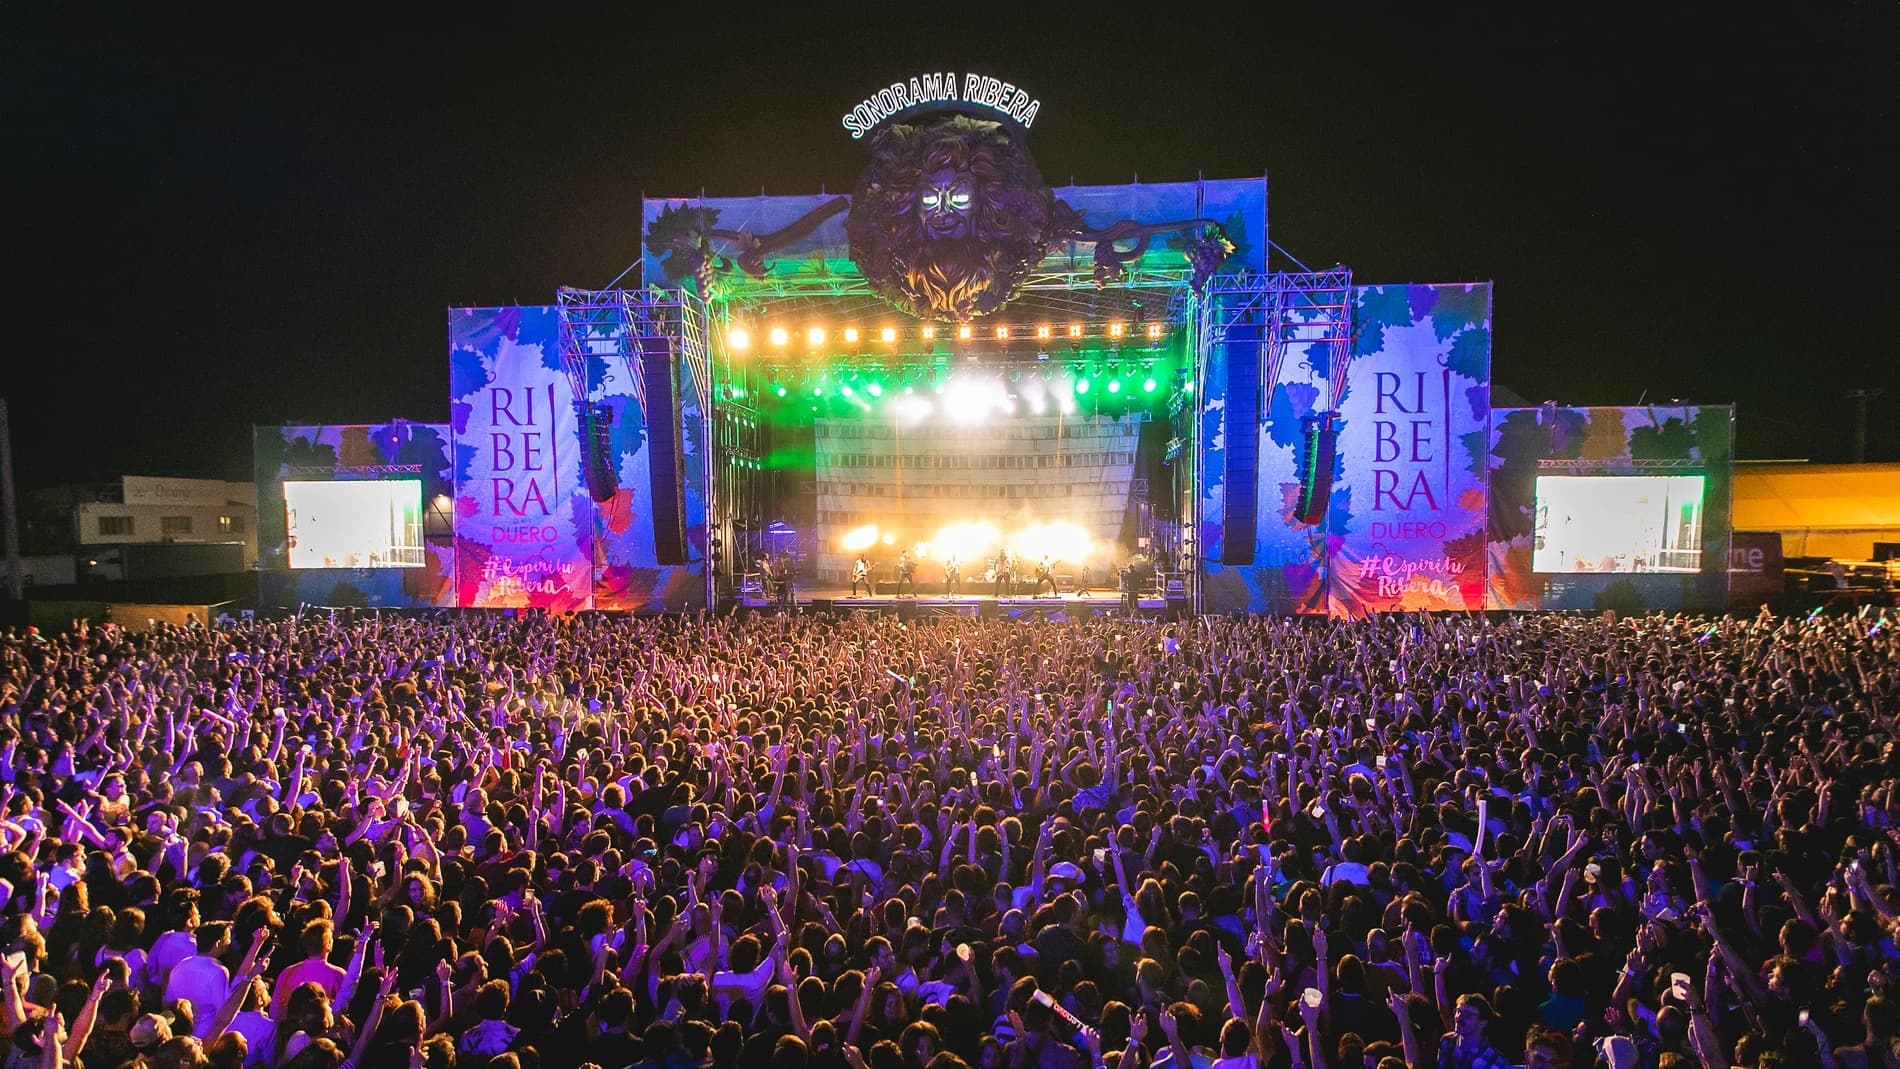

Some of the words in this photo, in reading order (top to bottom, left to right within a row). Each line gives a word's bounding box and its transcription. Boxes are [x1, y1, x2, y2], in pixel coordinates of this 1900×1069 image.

[843, 72, 958, 139] SONORAMA
[963, 73, 1040, 128] RIBERA
[488, 386, 536, 426] RI
[1372, 371, 1428, 414] RI
[489, 432, 543, 472] BE
[1372, 420, 1433, 463] BE
[491, 477, 551, 517] RA
[1371, 469, 1441, 512] RA
[492, 526, 558, 543] DUERO
[1372, 522, 1447, 540] DUERO
[494, 576, 571, 597] Ribera
[1377, 576, 1459, 598] Ribera
